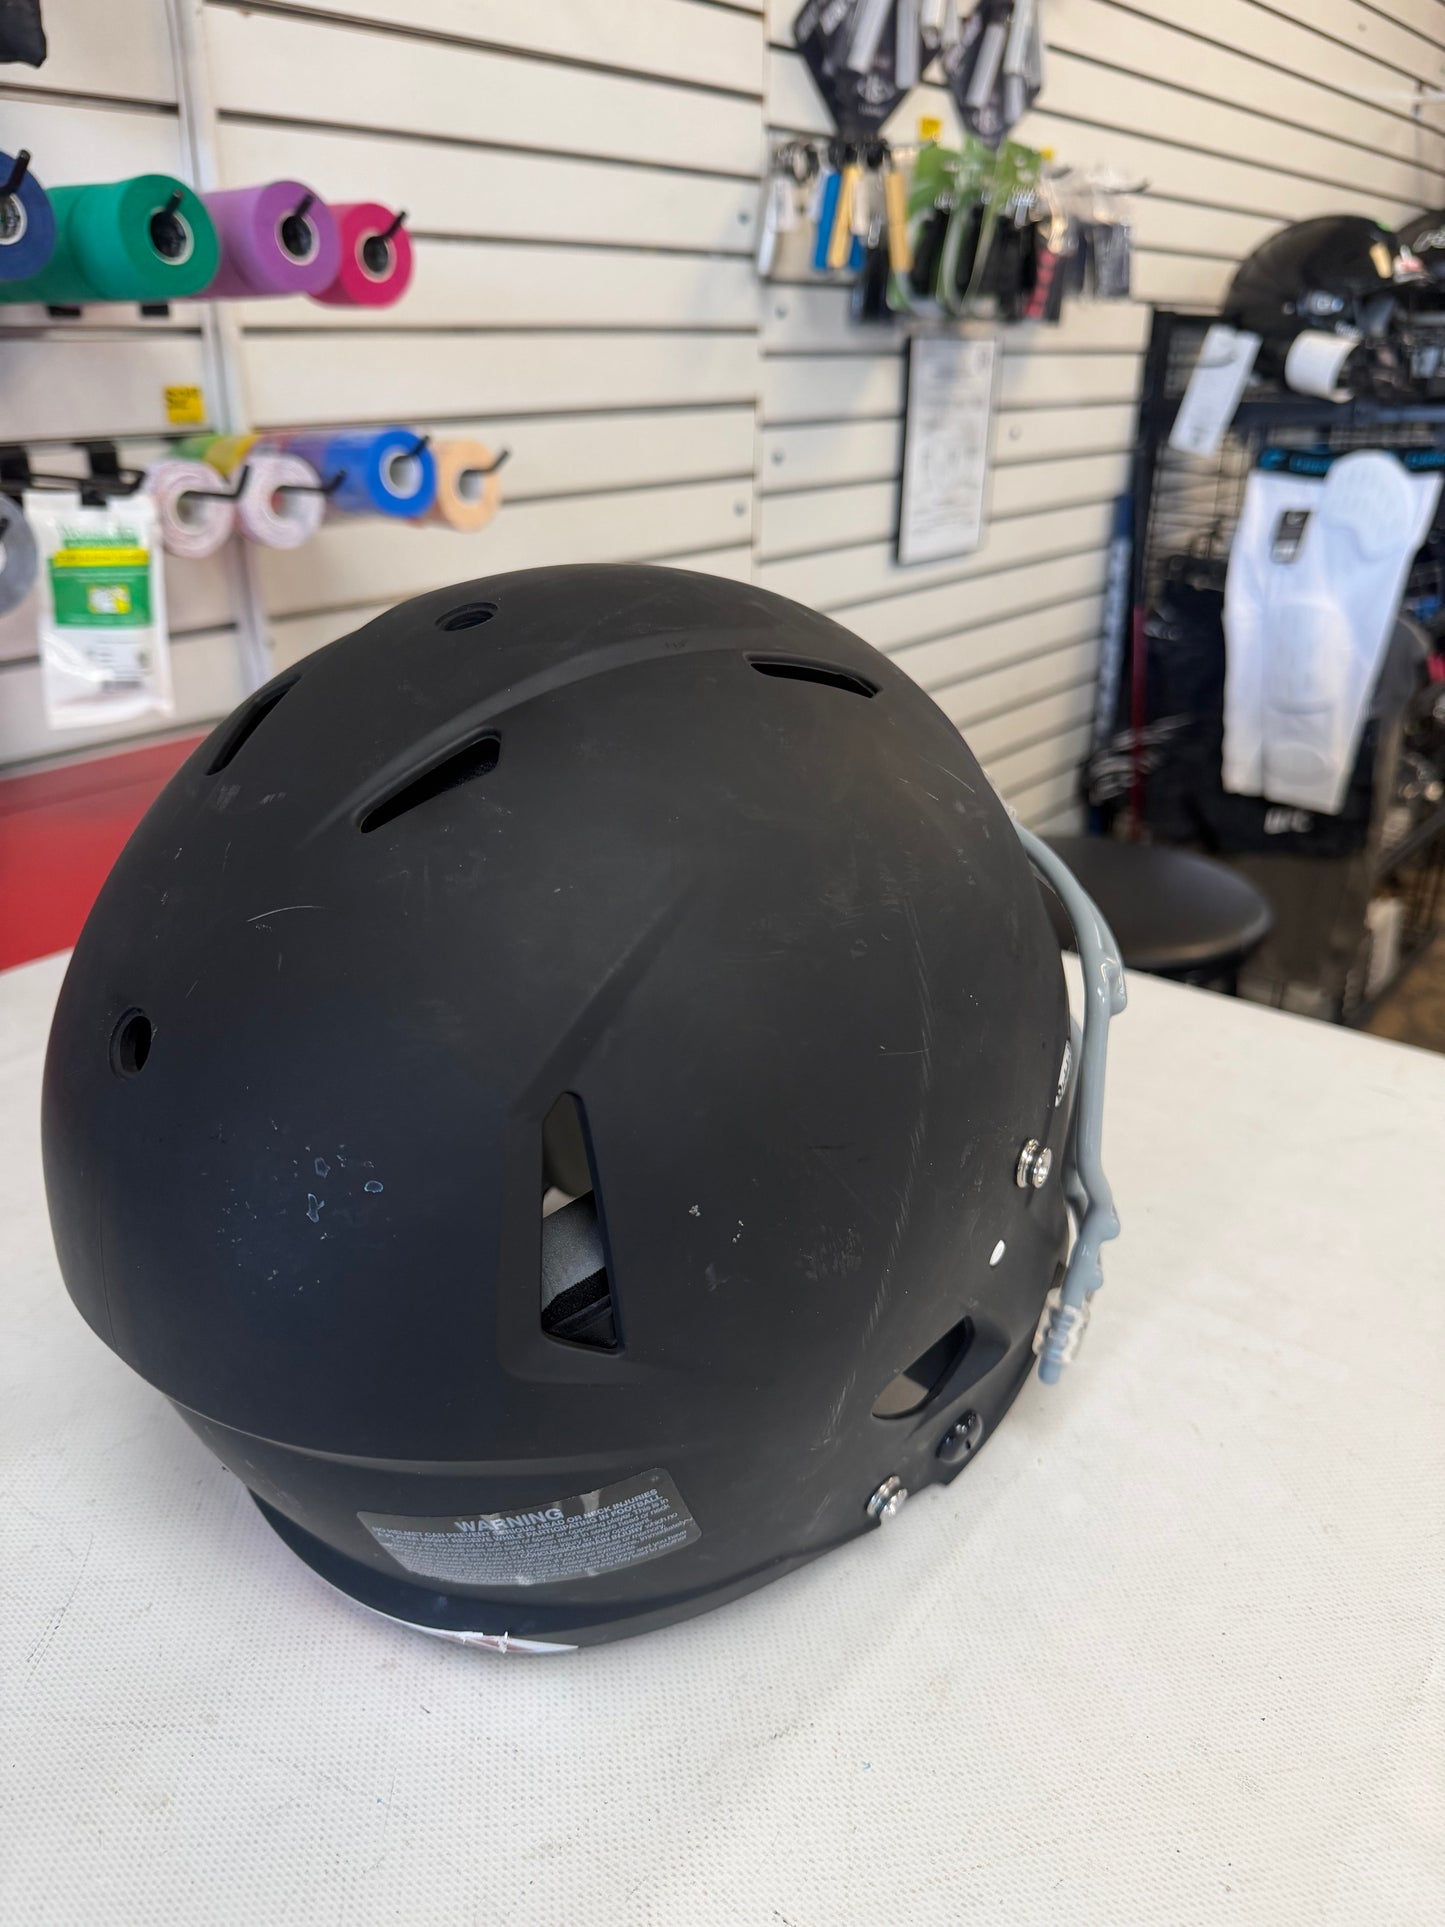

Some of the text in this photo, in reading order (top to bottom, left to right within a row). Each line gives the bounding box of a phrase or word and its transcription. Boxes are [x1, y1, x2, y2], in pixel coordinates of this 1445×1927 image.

[454, 1508, 564, 1532] WARNING
[492, 1525, 536, 1537] SERIOUS
[536, 1519, 566, 1530] HEAD
[566, 1515, 583, 1524] OR
[583, 1505, 612, 1518] NECK
[612, 1488, 658, 1510] INJURIES
[493, 1532, 525, 1542] WHILE
[525, 1516, 598, 1538] PARTICIPATING
[598, 1512, 610, 1521] IN
[611, 1494, 664, 1518] FOOTBALL
[531, 1532, 555, 1543] spear
[568, 1521, 606, 1535] opposing
[606, 1510, 634, 1526] player.
[632, 1504, 651, 1515] This
[541, 1538, 556, 1546] can
[557, 1533, 580, 1542] result
[590, 1522, 617, 1537] severe
[617, 1514, 639, 1527] head
[649, 1503, 670, 1515] neck
[611, 1524, 643, 1541] INJURY
[644, 1516, 667, 1528] which
[559, 1537, 582, 1549] injury
[592, 1530, 610, 1541] your
